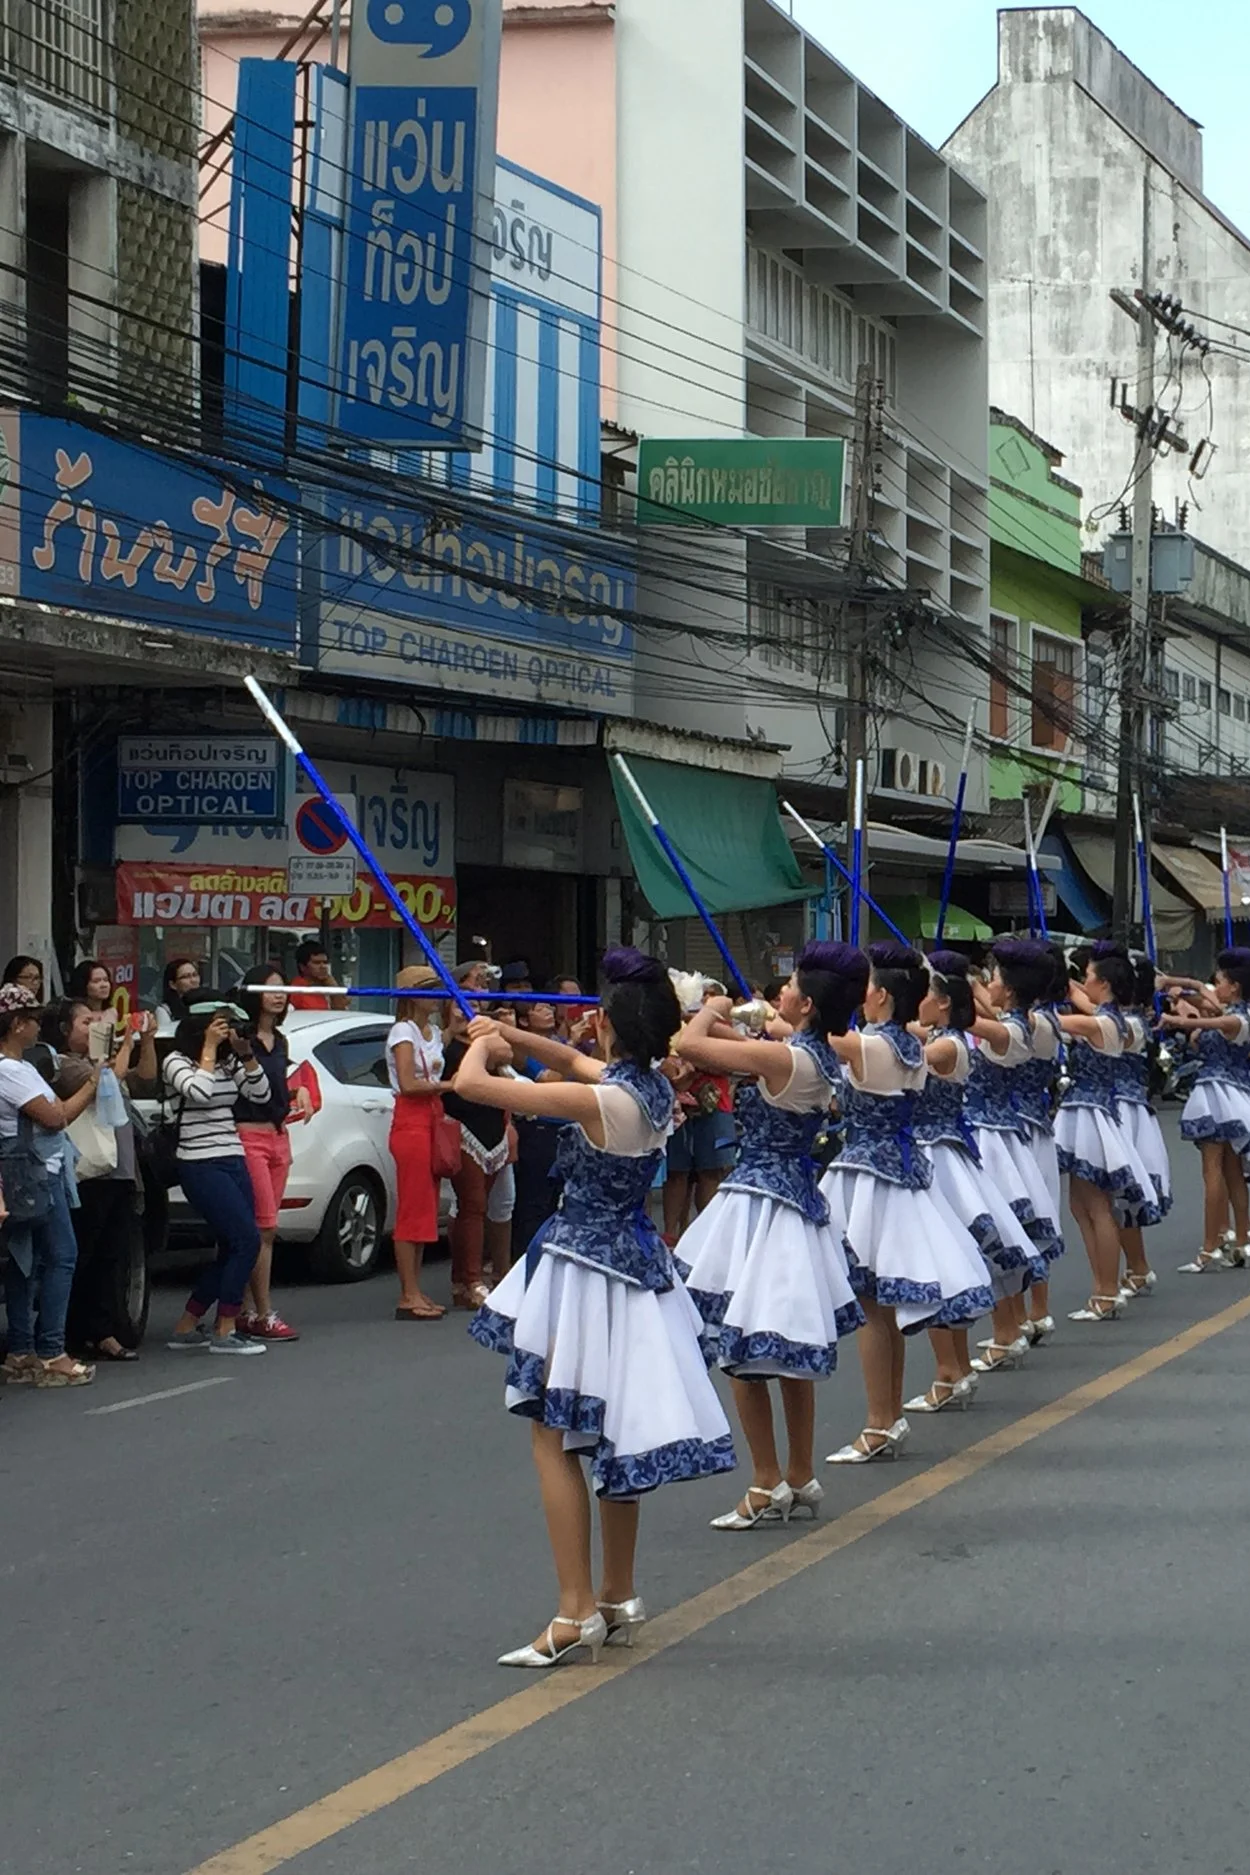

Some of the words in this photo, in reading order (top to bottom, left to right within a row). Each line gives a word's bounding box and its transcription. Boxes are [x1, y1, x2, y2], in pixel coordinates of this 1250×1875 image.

[362, 97, 466, 195] แว่น
[363, 199, 456, 306] ท็อป
[346, 325, 461, 430] เจริญ
[333, 619, 388, 658] TOP
[399, 631, 518, 684] CHAROEN
[527, 658, 617, 699] OPTICAL
[122, 770, 163, 790] TOP
[176, 770, 272, 791] CHAROEN
[128, 742, 267, 765] แว่นท็อปเจริญ
[136, 795, 256, 815] OPTICAL
[131, 885, 251, 921] แว่นตา
[258, 895, 309, 921] ลด
